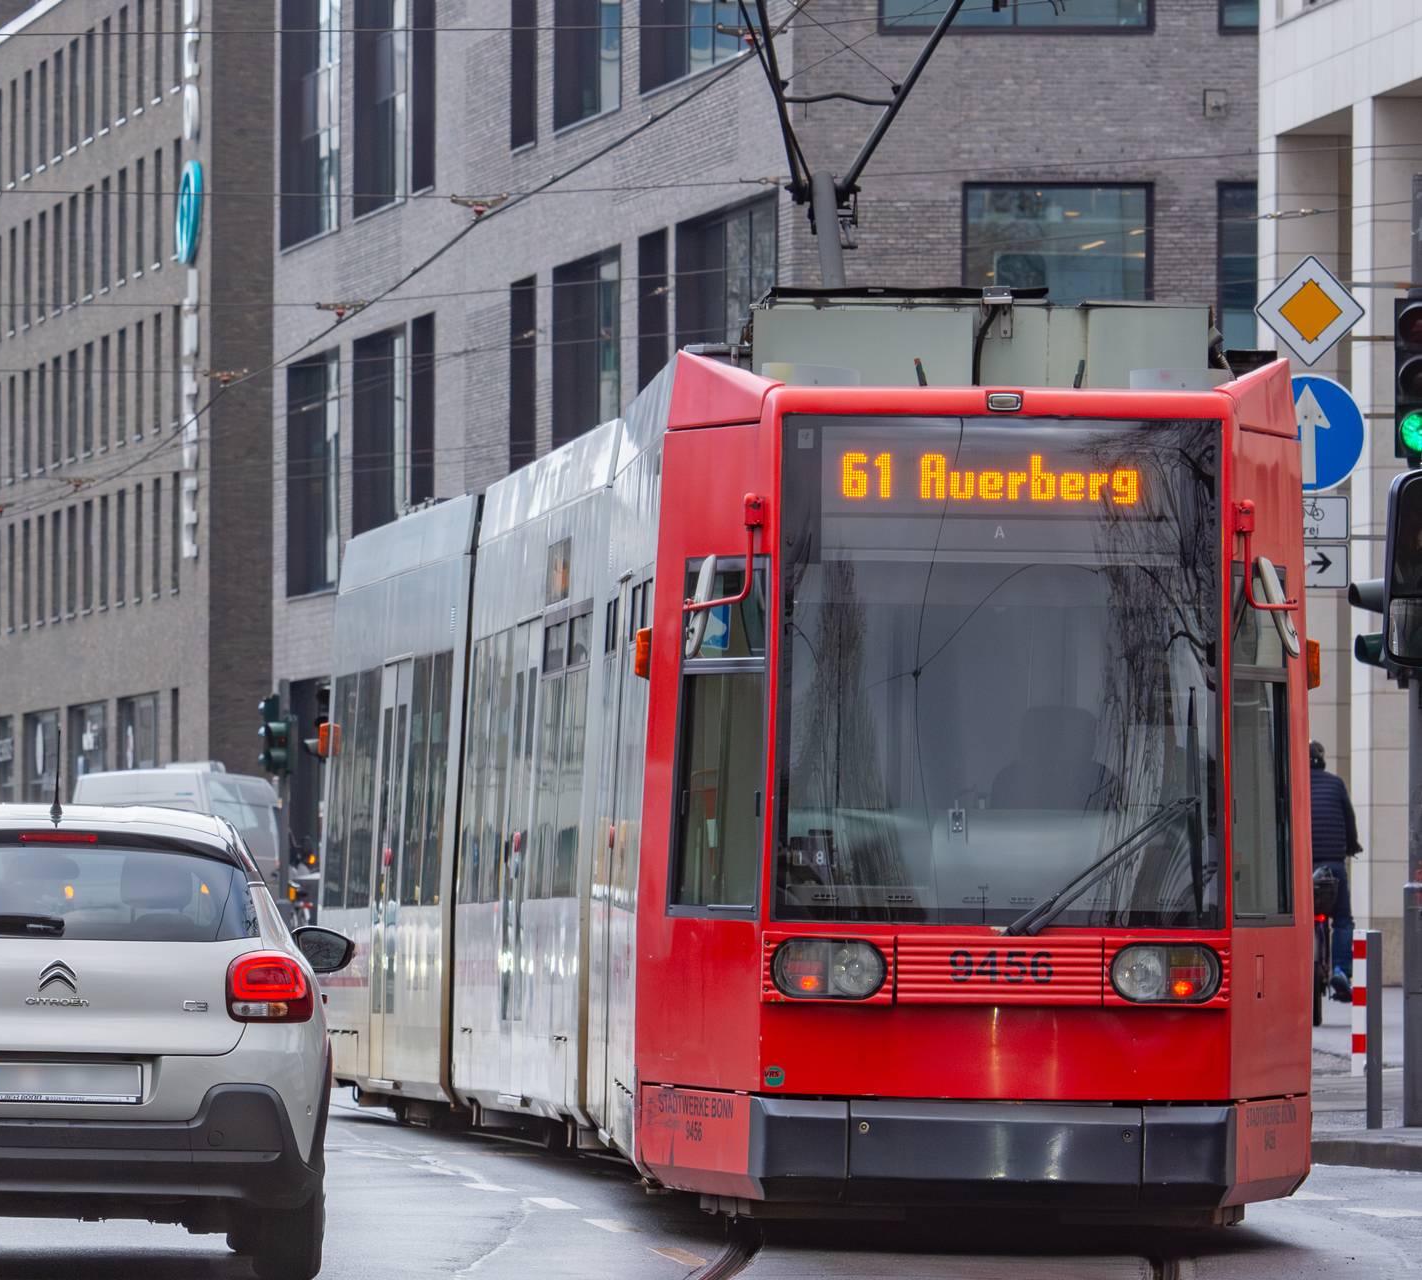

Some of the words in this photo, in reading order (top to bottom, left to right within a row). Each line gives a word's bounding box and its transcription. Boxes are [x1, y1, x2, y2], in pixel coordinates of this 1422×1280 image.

[841, 452, 891, 499] 61
[920, 453, 1140, 505] Auerberg
[994, 525, 1005, 539] A
[1303, 523, 1319, 536] rei
[949, 950, 1054, 984] 9456
[182, 1001, 208, 1013] C3
[659, 1095, 709, 1118] STADTWERKE
[711, 1098, 734, 1119] BONN
[685, 1120, 703, 1142] 9456
